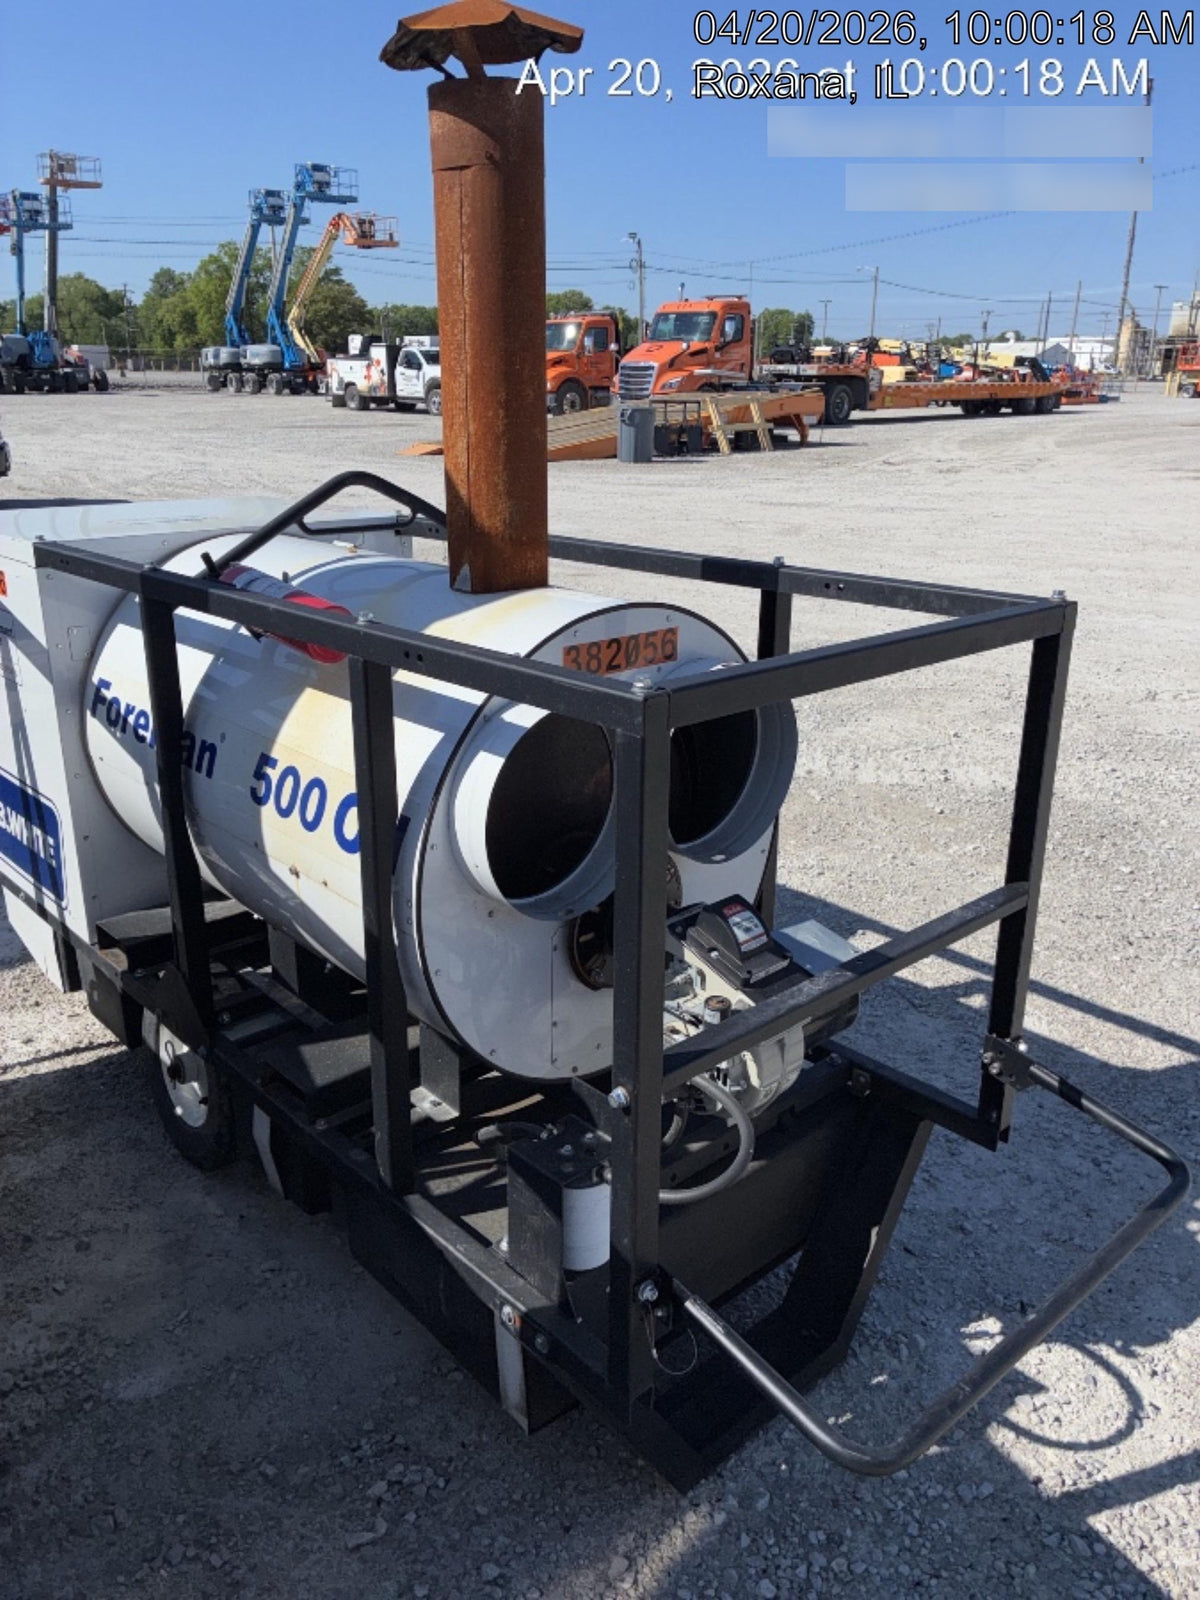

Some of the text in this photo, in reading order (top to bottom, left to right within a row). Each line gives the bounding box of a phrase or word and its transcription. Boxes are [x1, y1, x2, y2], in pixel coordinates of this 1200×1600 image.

[566, 627, 677, 673] 382056
[91, 677, 218, 779] Forean
[250, 752, 327, 832] 500
